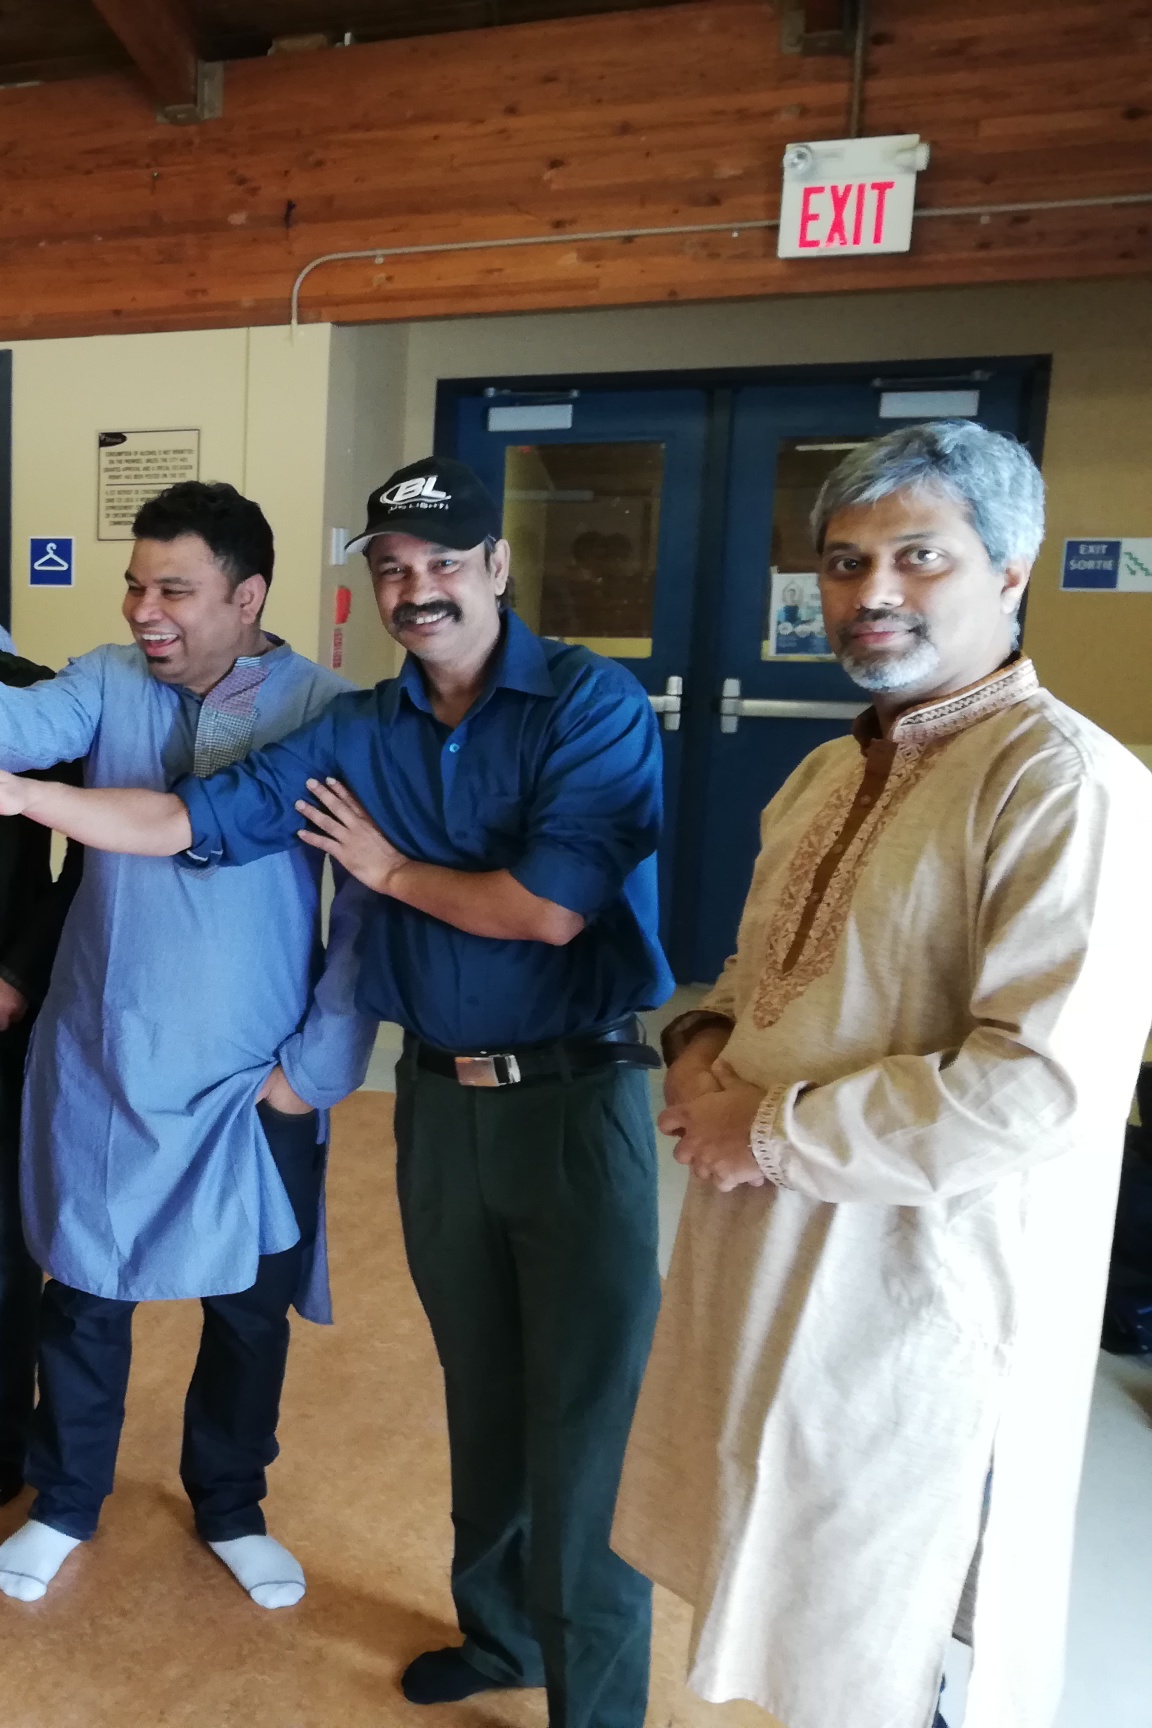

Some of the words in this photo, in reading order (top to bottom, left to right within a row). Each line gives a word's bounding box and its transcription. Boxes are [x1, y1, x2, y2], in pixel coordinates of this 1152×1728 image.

[798, 181, 895, 248] EXIT
[1079, 544, 1108, 555] EXIT
[1069, 559, 1114, 571] SORTIE
